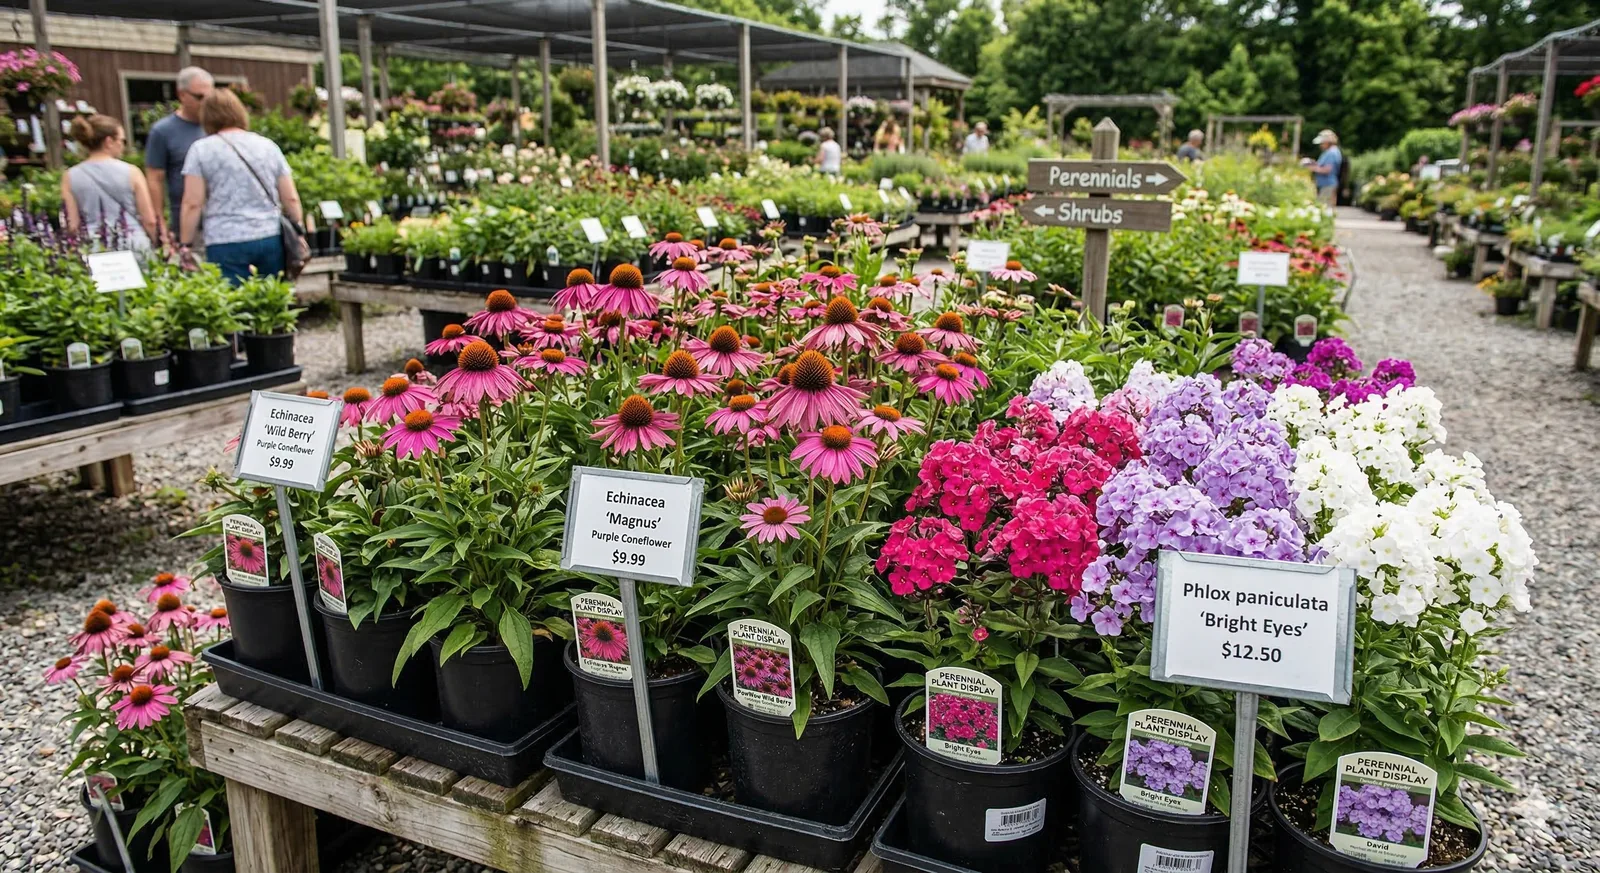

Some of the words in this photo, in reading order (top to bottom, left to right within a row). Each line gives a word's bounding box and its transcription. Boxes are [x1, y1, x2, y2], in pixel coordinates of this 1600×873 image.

[1050, 165, 1142, 189] Perennials
[1057, 201, 1123, 224] Shrubs
[270, 408, 314, 424] Echinacea
[256, 439, 277, 450] Purple
[277, 442, 314, 455] Coneflower
[269, 455, 294, 469] $9.99
[606, 491, 665, 508] Echinacea
[606, 511, 661, 529] ‘Magnus’
[591, 530, 619, 542] Purple
[621, 534, 672, 548] Coneflower
[612, 549, 646, 566] $9.99
[580, 598, 616, 608] PERENNIAL
[1183, 583, 1230, 601] Phlox
[1236, 591, 1328, 612] paniculata
[576, 604, 596, 612] PLANT
[597, 607, 623, 616] DISPLAY
[740, 624, 779, 637] PERENNIAL
[1200, 610, 1257, 633] ‘Bright
[1263, 619, 1308, 637] Eyes’
[733, 630, 755, 640] PLANT
[756, 634, 786, 646] DISPLAY
[1221, 640, 1282, 663] $12.50
[931, 678, 958, 689] PLANT
[960, 683, 996, 696] DISPLAY
[939, 672, 986, 686] PERENNIAL
[1134, 720, 1166, 734] PLANT
[1168, 727, 1208, 743] DISPLAY
[1145, 714, 1199, 733] PERENNIAL
[944, 742, 965, 752] Bright
[1357, 757, 1418, 774] PERENNIAL
[1345, 764, 1381, 777] PLANT
[1383, 771, 1428, 785] DISPLAY
[1140, 790, 1162, 802] Bright
[1366, 841, 1389, 851] David
